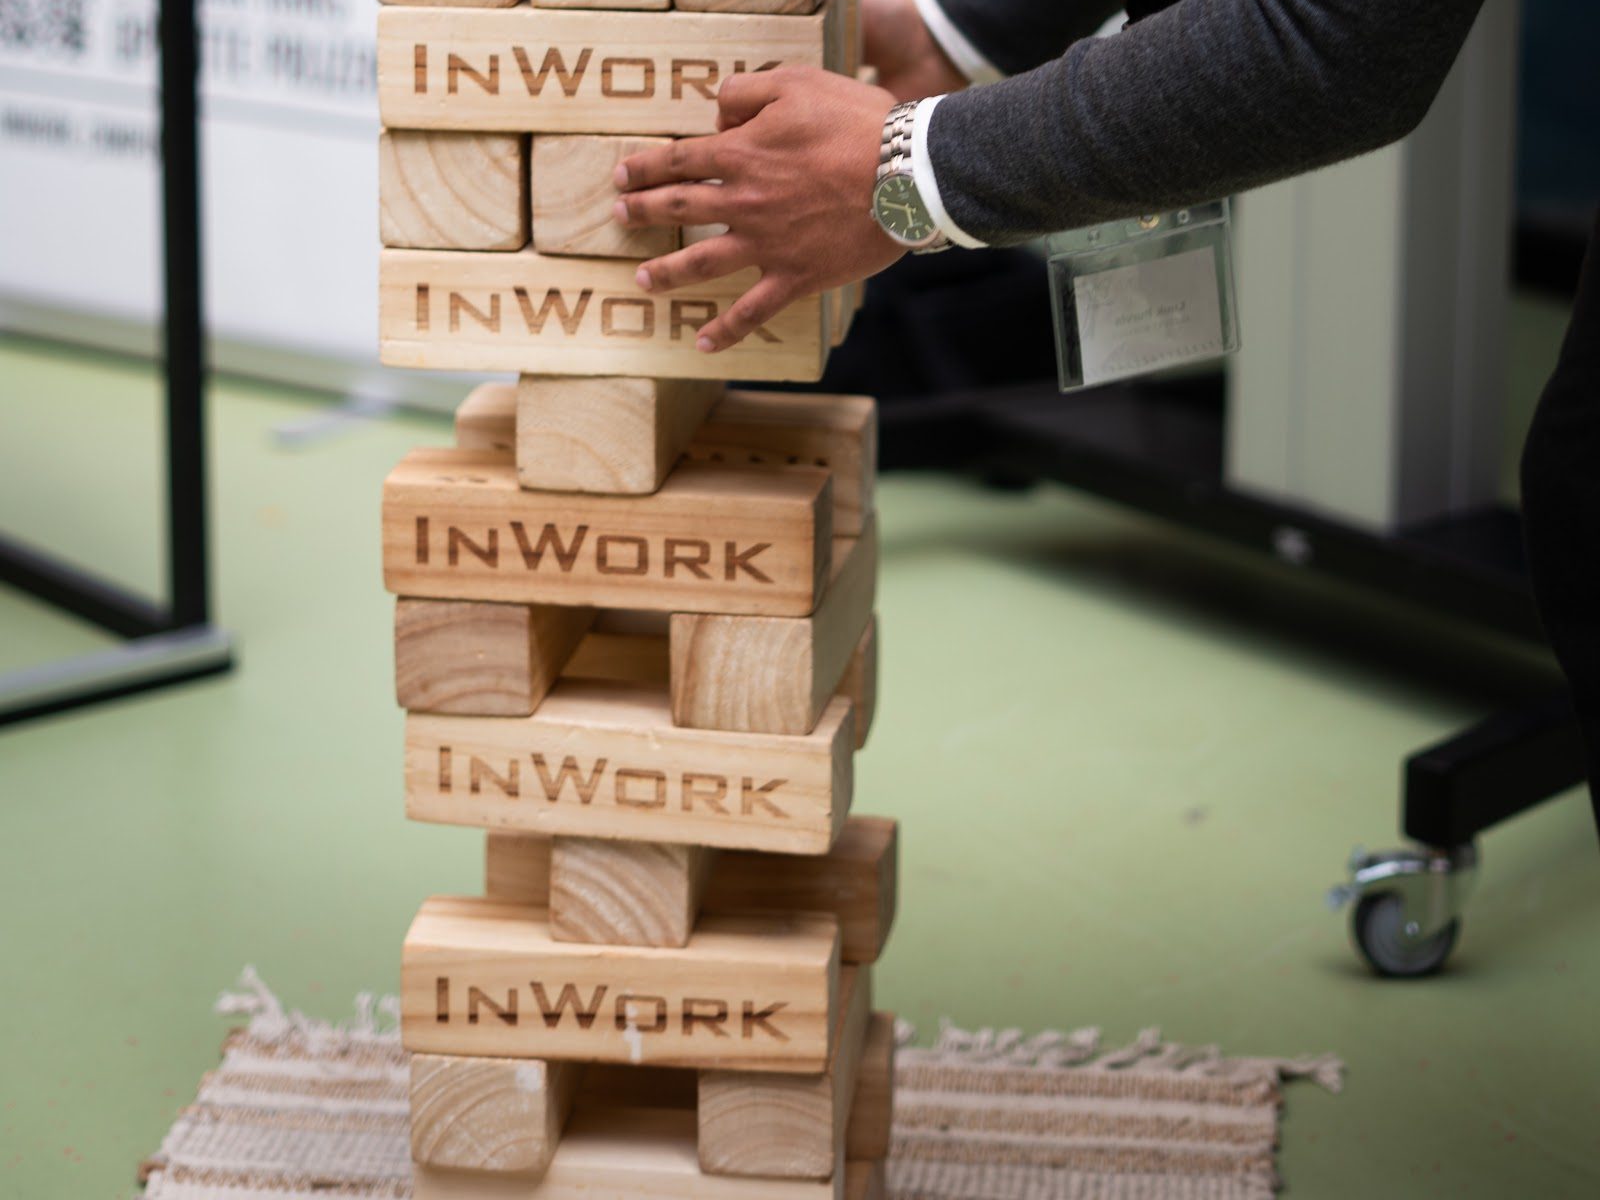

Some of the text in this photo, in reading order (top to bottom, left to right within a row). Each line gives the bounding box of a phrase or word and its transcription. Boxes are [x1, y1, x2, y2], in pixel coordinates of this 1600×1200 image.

[415, 516, 775, 584] INWORK
[438, 745, 792, 818] INWORK
[436, 976, 792, 1041] INWORK
